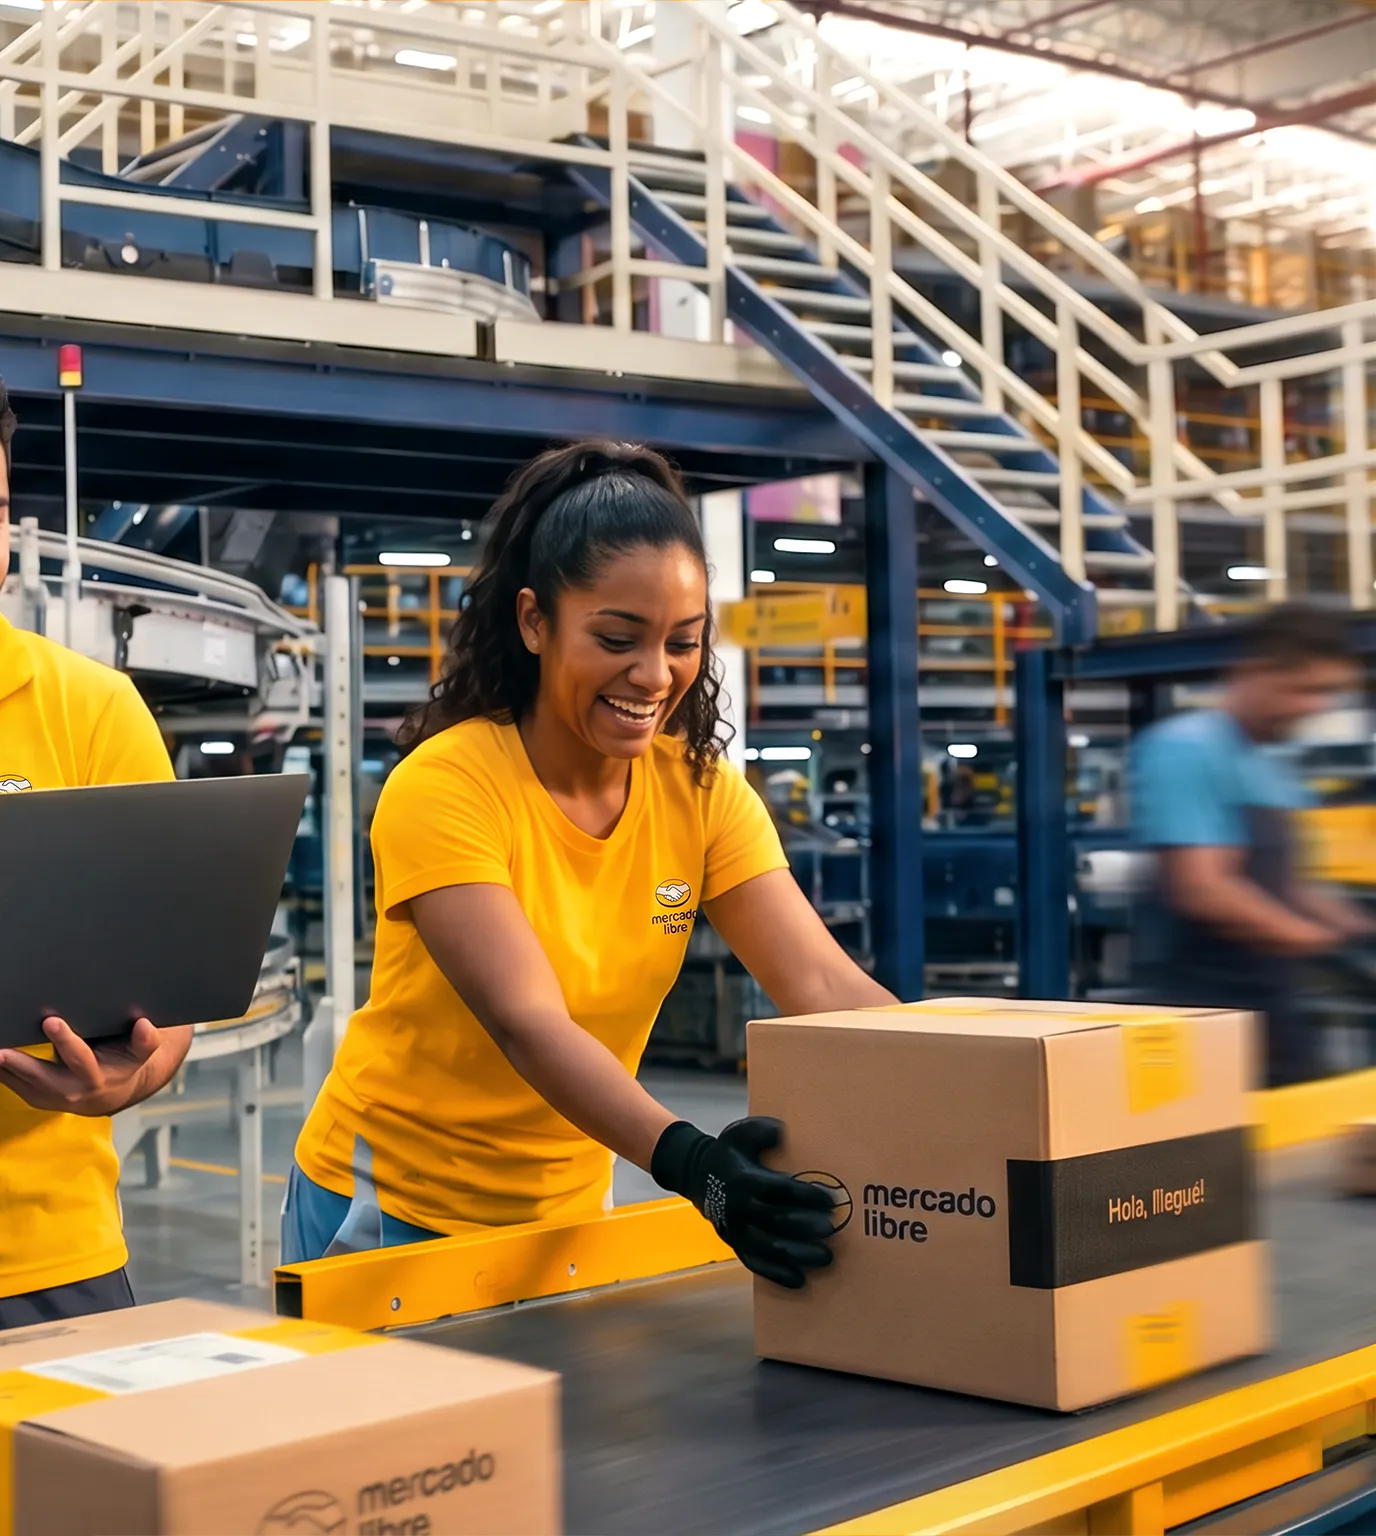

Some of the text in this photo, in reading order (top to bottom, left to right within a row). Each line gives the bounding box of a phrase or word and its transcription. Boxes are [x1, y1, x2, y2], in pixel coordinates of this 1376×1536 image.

[651, 908, 698, 925] mercado
[663, 923, 688, 935] libre
[863, 1183, 996, 1219] mercado
[1108, 1194, 1148, 1224] Hola,
[864, 1208, 928, 1243] libre
[357, 1448, 496, 1515] mercado
